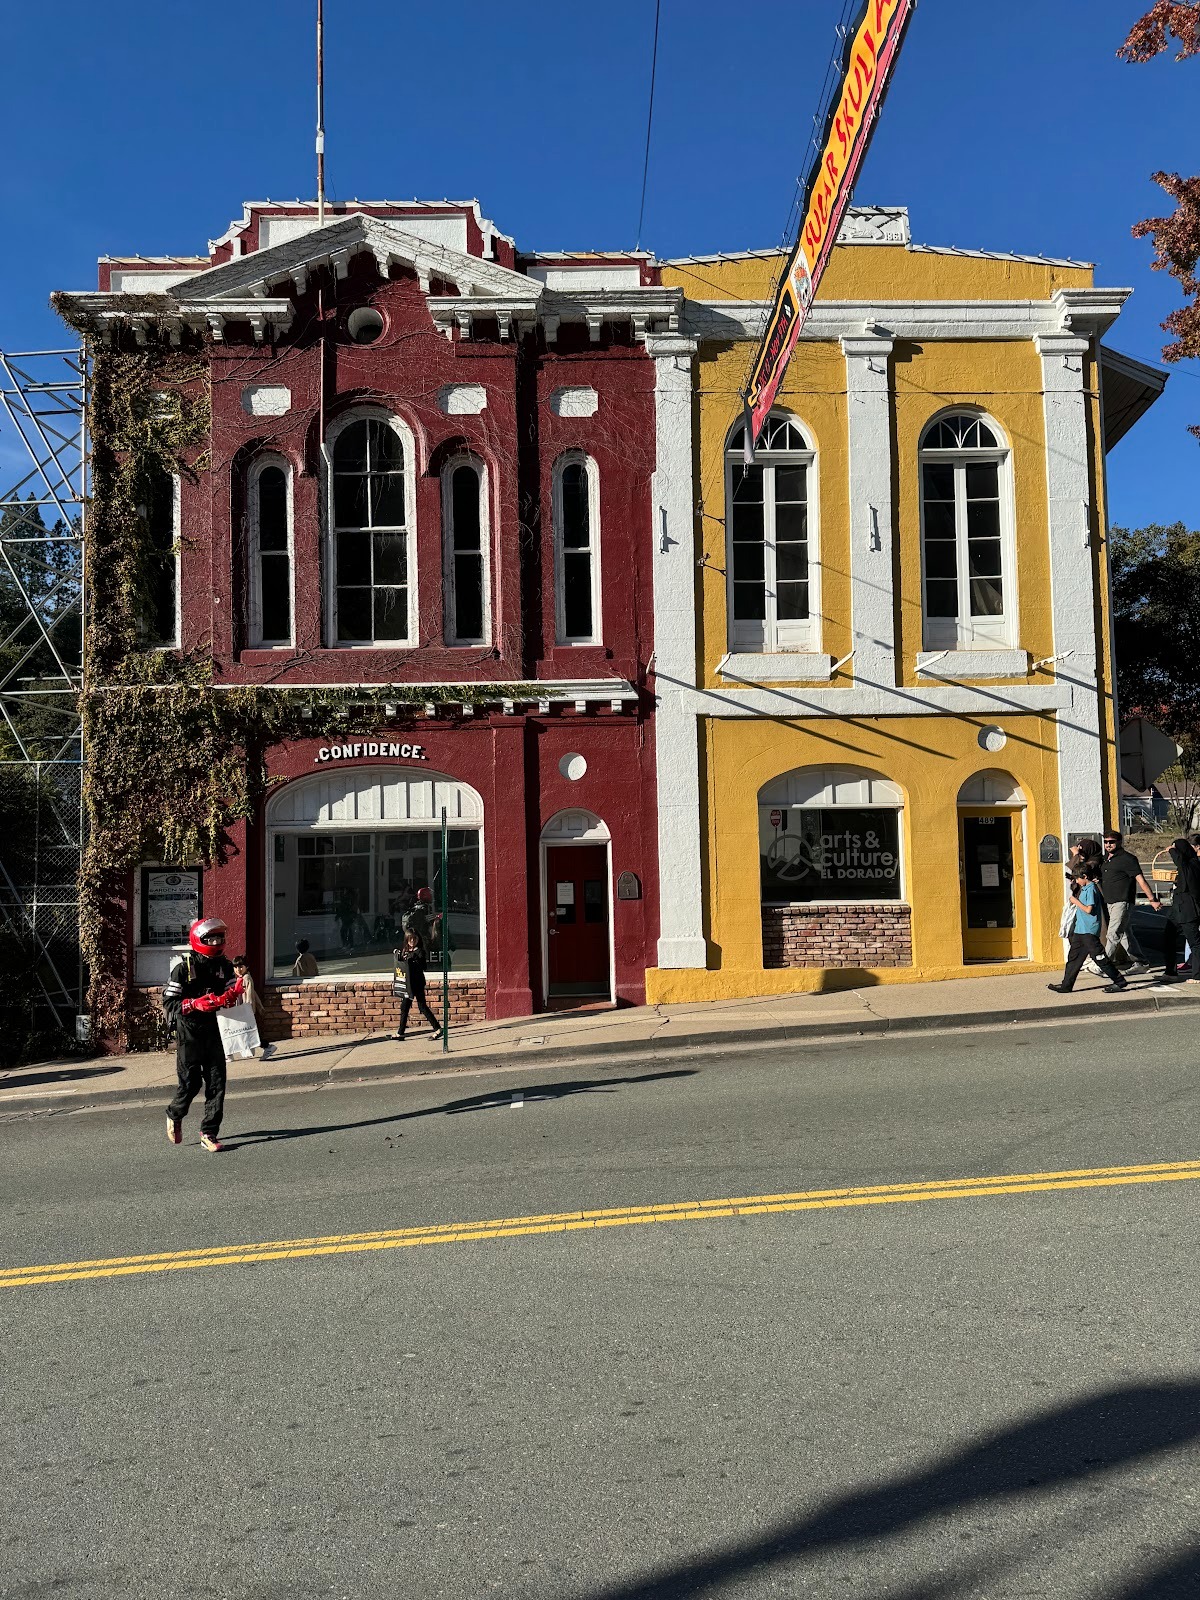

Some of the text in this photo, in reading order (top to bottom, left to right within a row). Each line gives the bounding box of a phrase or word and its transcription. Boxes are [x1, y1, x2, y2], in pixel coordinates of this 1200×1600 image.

[806, 151, 839, 258] SUGAR
[835, 29, 875, 160] SKULL
[820, 830, 880, 848] arts &
[821, 849, 893, 867] culture
[821, 868, 894, 879] EL DORADO
